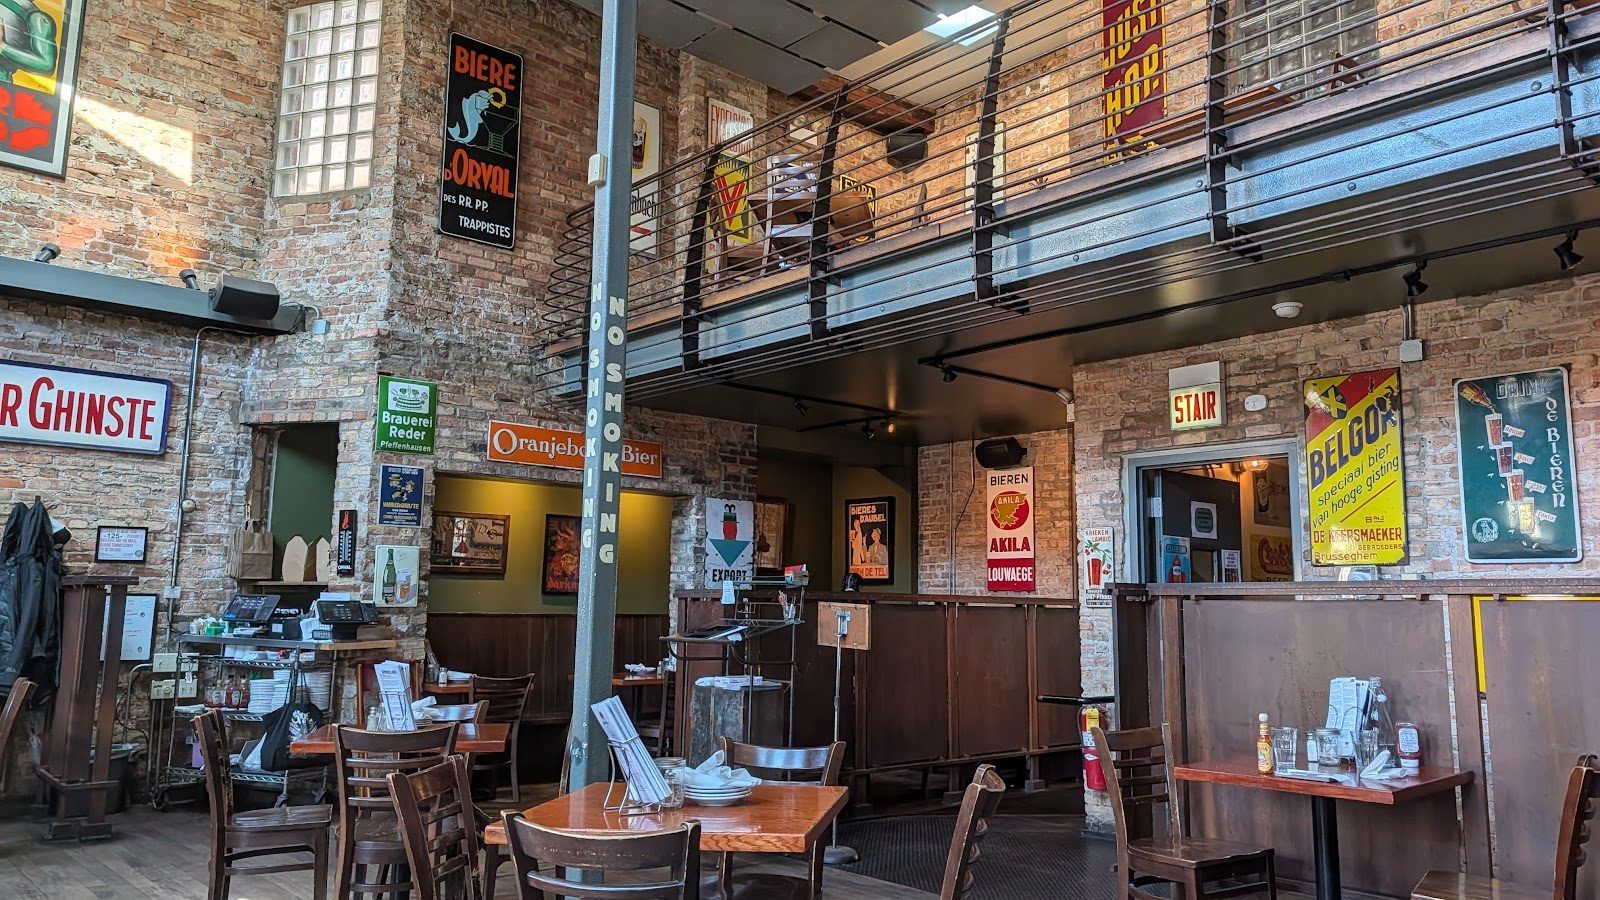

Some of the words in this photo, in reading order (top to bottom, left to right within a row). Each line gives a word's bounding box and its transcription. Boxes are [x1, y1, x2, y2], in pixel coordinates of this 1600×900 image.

[454, 45, 516, 91] BIERE
[443, 193, 457, 204] DES
[475, 198, 489, 213] PP.
[458, 214, 511, 238] TRAPPISTES
[591, 281, 602, 332] NO
[607, 295, 625, 347] NO
[28, 376, 157, 441] GHINSTE
[1174, 390, 1216, 424] STAIR
[382, 411, 433, 428] Brauerei
[389, 425, 426, 440] Reder
[380, 440, 431, 452] Pfeffenhausen
[492, 428, 586, 459] Oranjebo
[621, 444, 658, 465] Bier
[582, 348, 600, 549] SMOKING
[598, 362, 623, 564] SMOKING
[990, 473, 1029, 486] BIEREN
[1317, 461, 1365, 507] speciaal
[1368, 442, 1392, 468] bier
[997, 495, 1020, 505] AKILA
[1312, 509, 1329, 529] van
[1331, 484, 1363, 514] hooge
[1365, 455, 1400, 492] gisting
[851, 505, 877, 515] BIERES
[989, 536, 1031, 553] AKILA
[1313, 530, 1325, 543] DE
[712, 568, 747, 582] EXPORT
[987, 566, 1033, 582] LOUWAEGE
